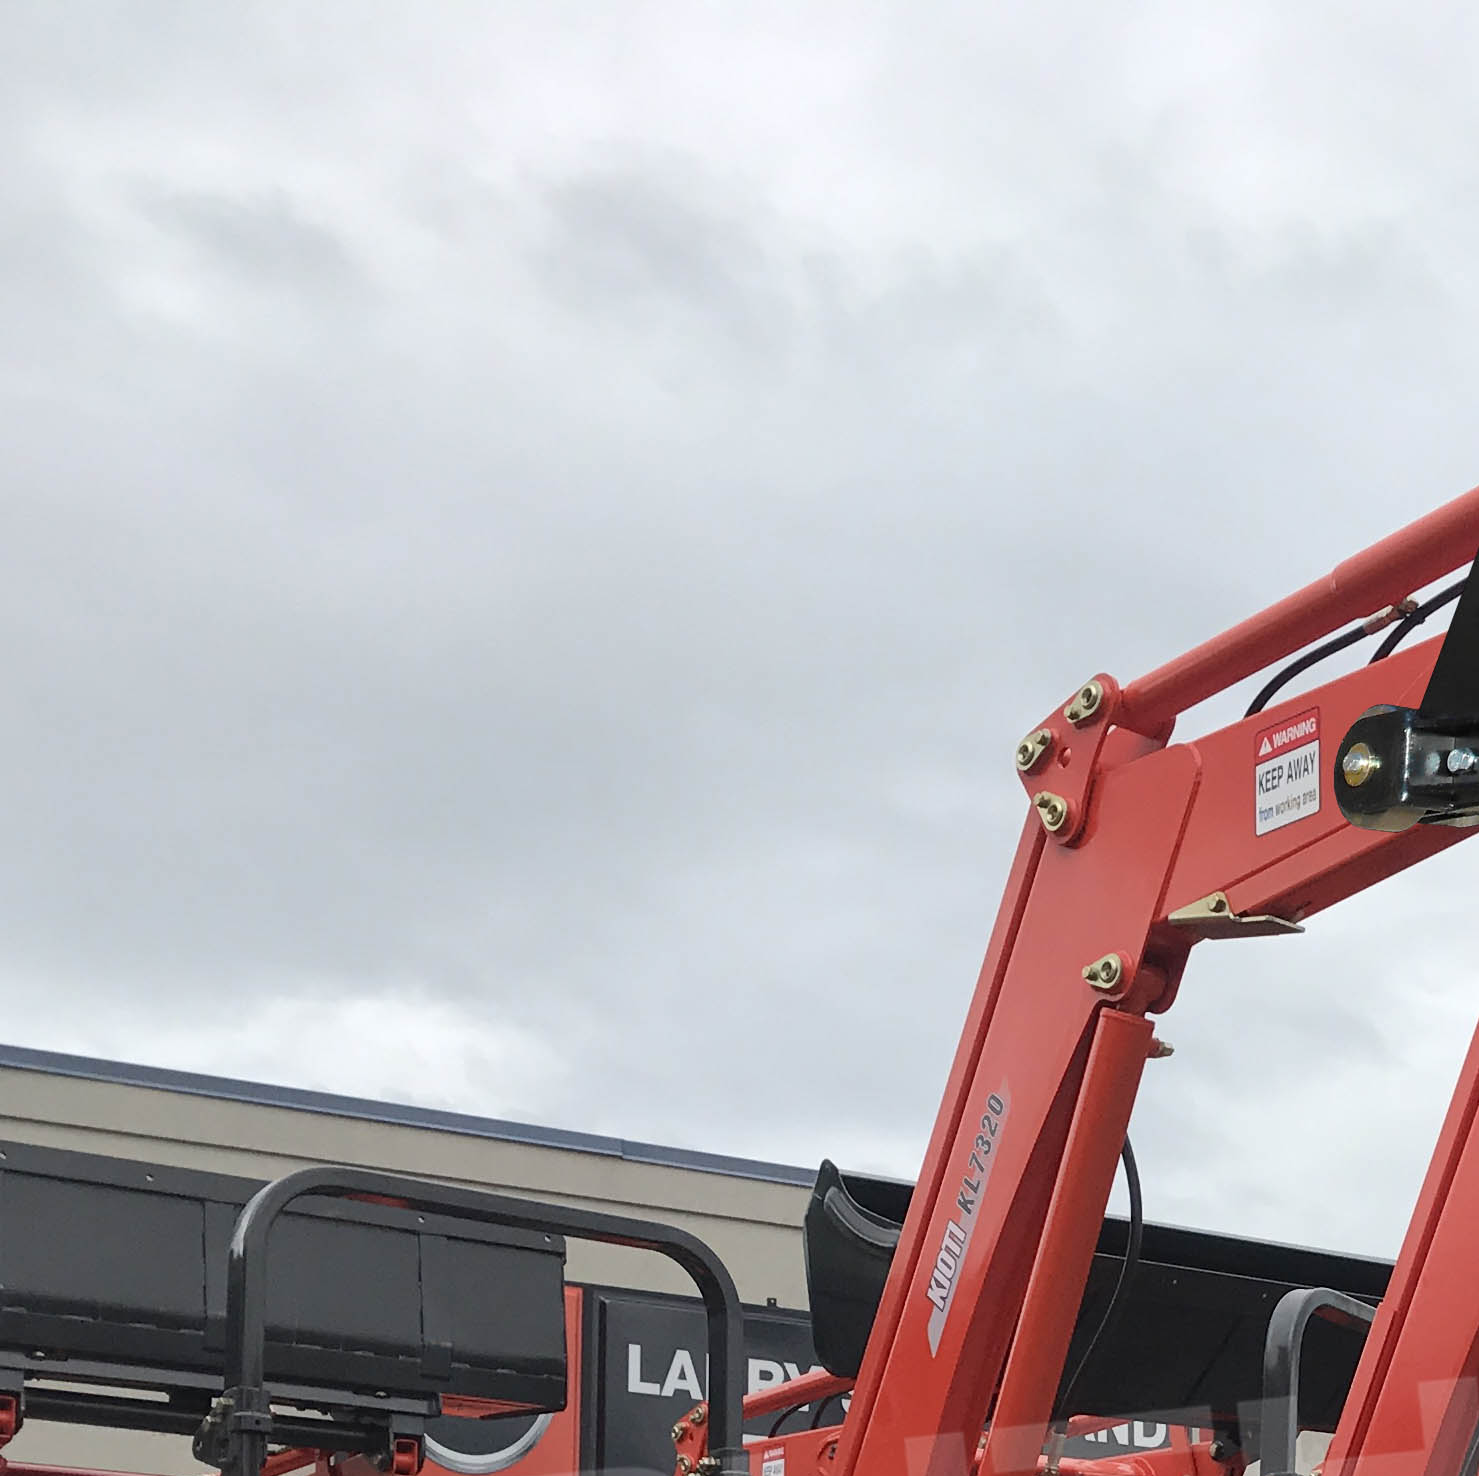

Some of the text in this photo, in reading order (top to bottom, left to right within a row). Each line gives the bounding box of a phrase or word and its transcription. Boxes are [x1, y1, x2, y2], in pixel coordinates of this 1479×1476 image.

[1272, 717, 1317, 748] WARNING
[1258, 751, 1316, 795] KEEP AWAY
[1259, 788, 1317, 823] from working area
[925, 1092, 1006, 1312] KIOTI KL7320
